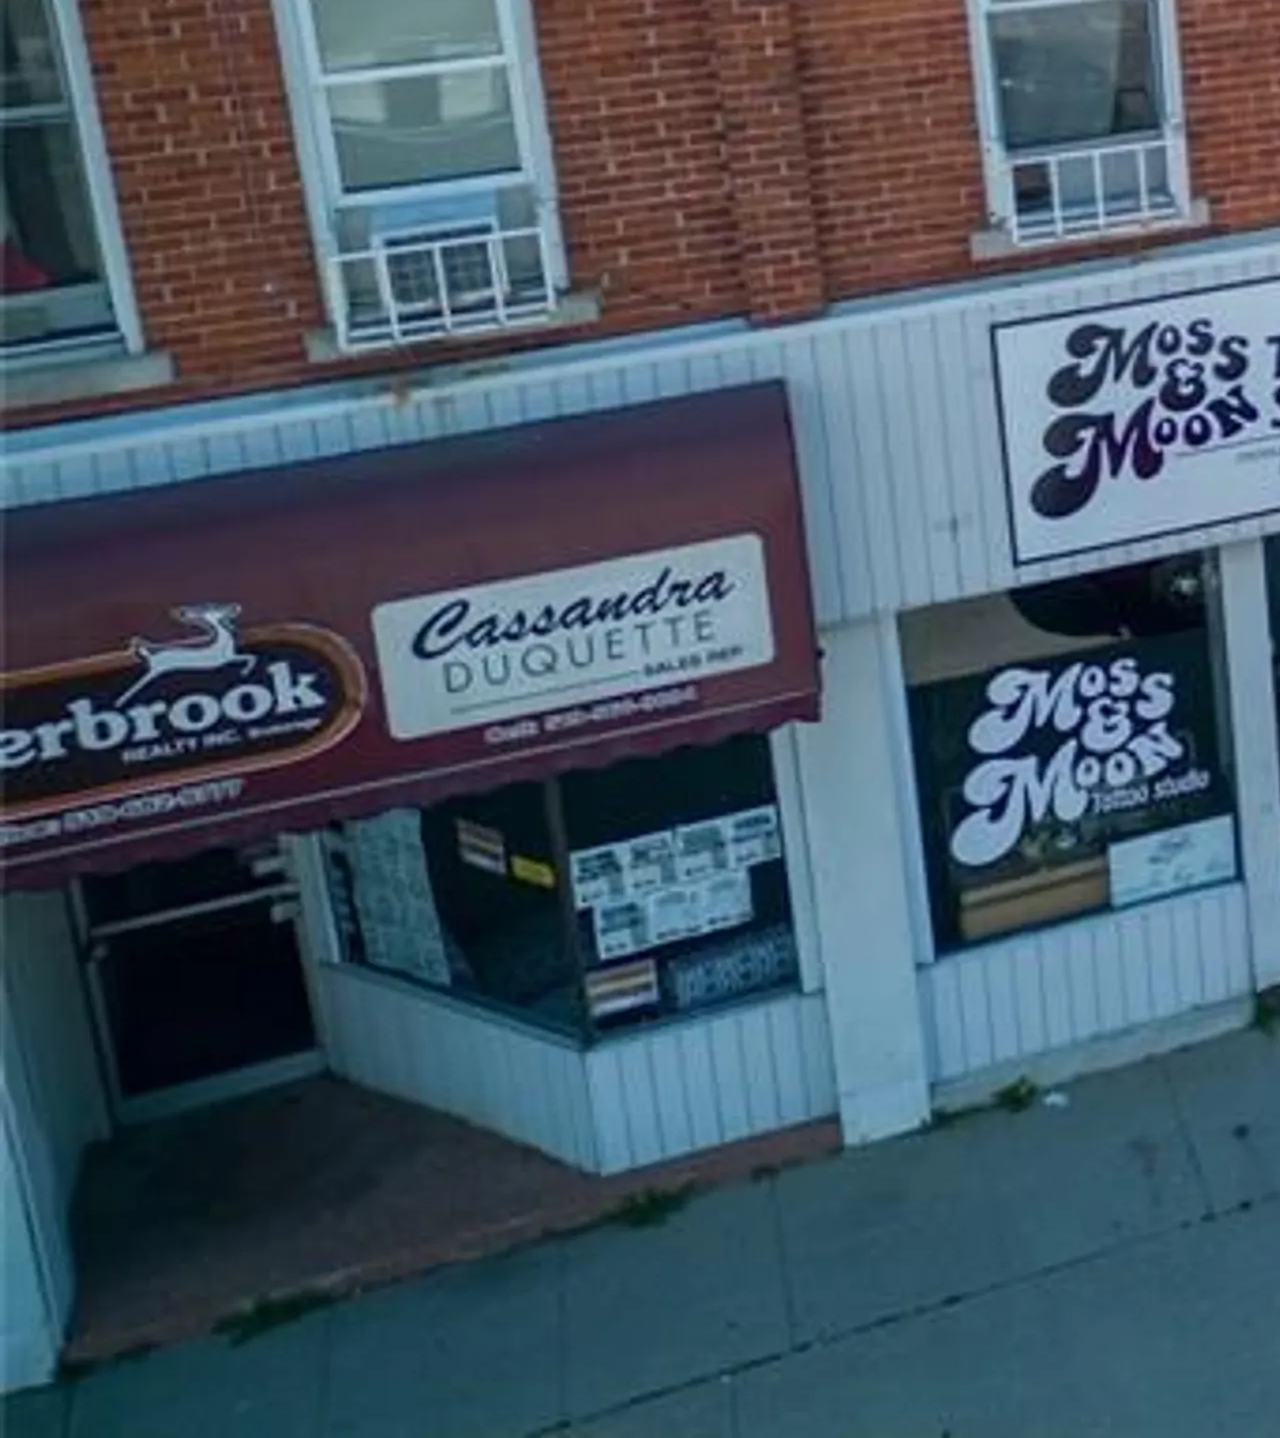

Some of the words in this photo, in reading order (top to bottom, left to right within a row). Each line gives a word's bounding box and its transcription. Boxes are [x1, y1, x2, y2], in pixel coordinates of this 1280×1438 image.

[1159, 359, 1207, 412] &
[412, 567, 736, 660] Cassandra
[441, 611, 717, 694] DUQUETTE
[121, 735, 200, 763] REALTY
[1081, 697, 1132, 752] &
